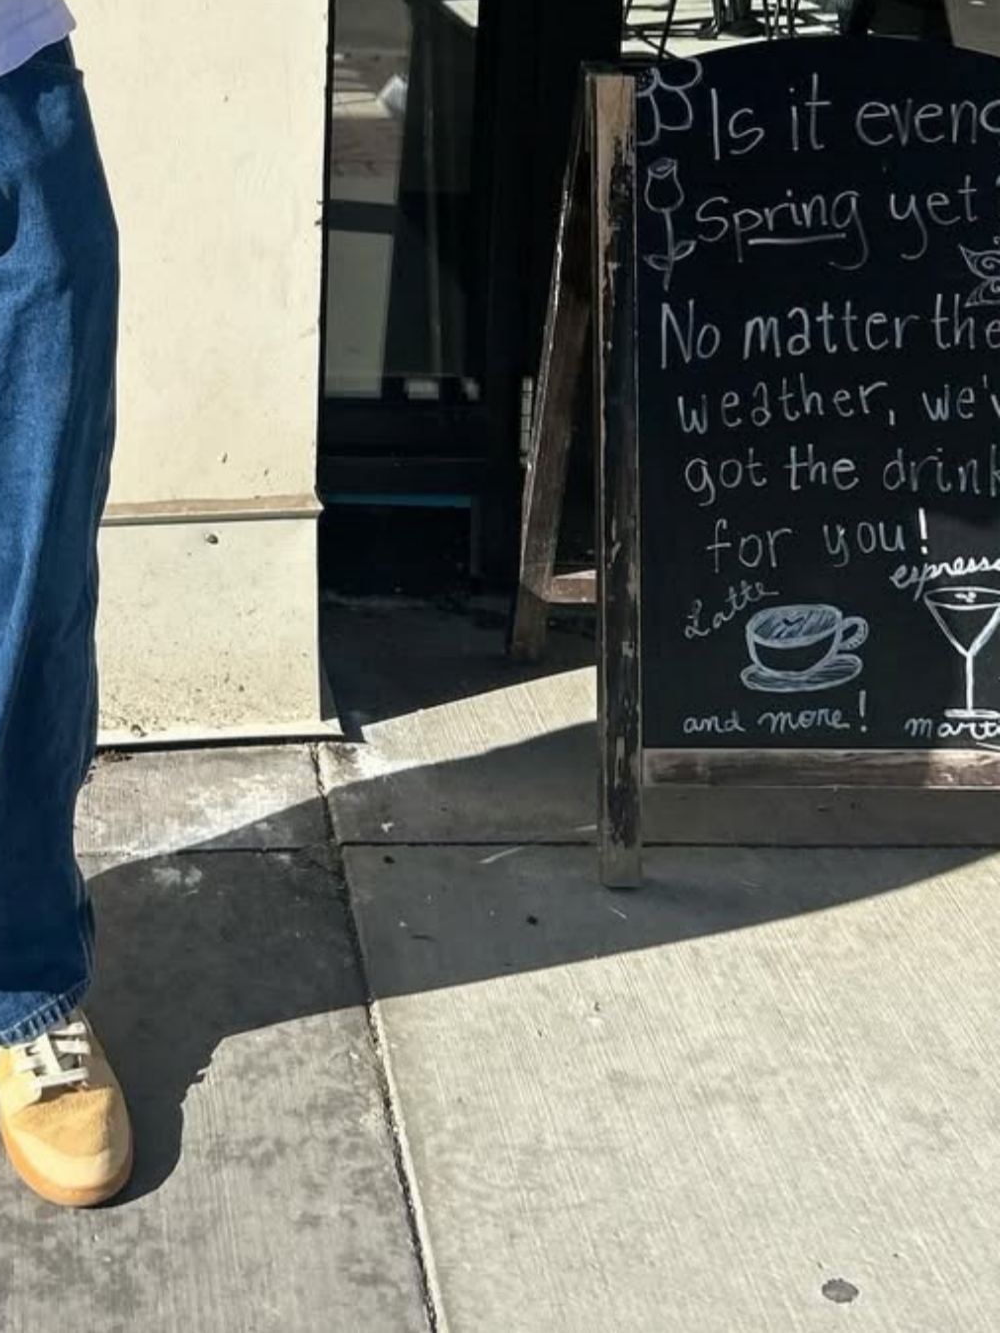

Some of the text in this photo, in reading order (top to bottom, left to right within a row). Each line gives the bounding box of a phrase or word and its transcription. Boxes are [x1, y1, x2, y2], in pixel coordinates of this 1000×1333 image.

[711, 87, 766, 160] Is
[790, 72, 832, 152] it
[696, 188, 870, 271] Spring
[660, 292, 1000, 370] No matter the
[677, 372, 897, 434] weather,
[684, 447, 768, 508] got
[783, 442, 860, 492] the
[705, 507, 929, 574] for you!
[683, 578, 780, 640] Latte
[683, 689, 870, 735] and more!
